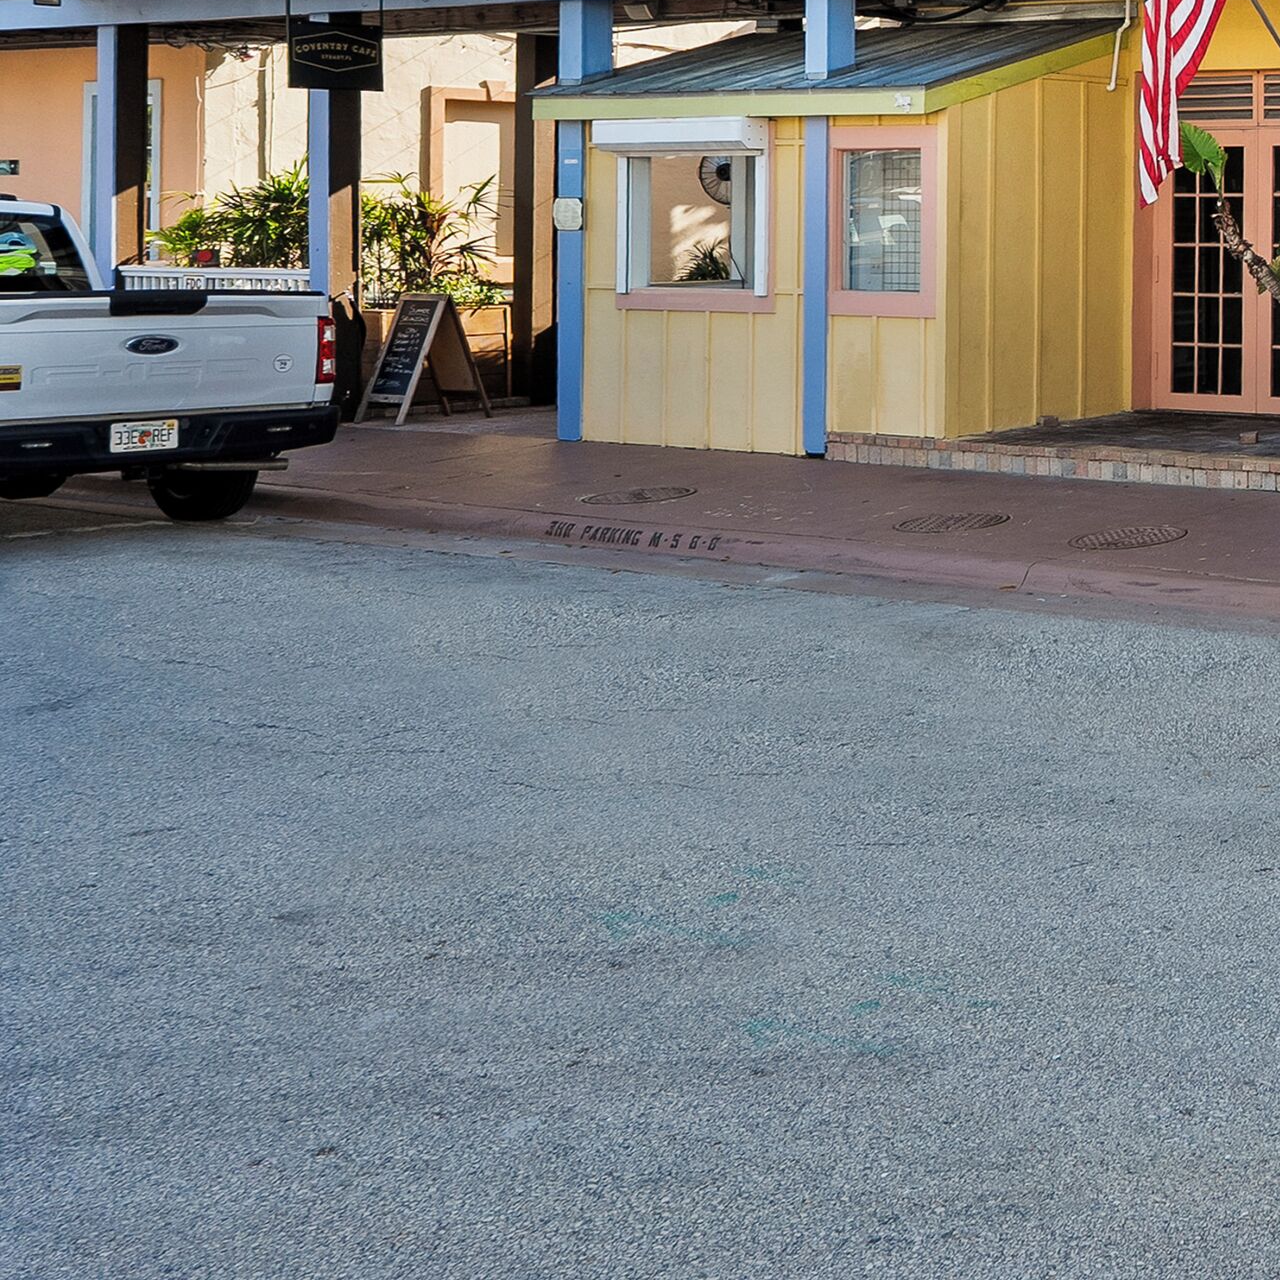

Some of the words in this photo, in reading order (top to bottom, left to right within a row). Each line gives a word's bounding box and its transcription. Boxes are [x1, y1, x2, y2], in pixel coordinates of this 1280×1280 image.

[295, 42, 349, 53] COVENTRY
[351, 45, 377, 58] CAFE
[114, 429, 139, 446] 33E
[152, 427, 175, 443] REF
[545, 520, 577, 538] 3HR
[580, 524, 643, 546] PARKING
